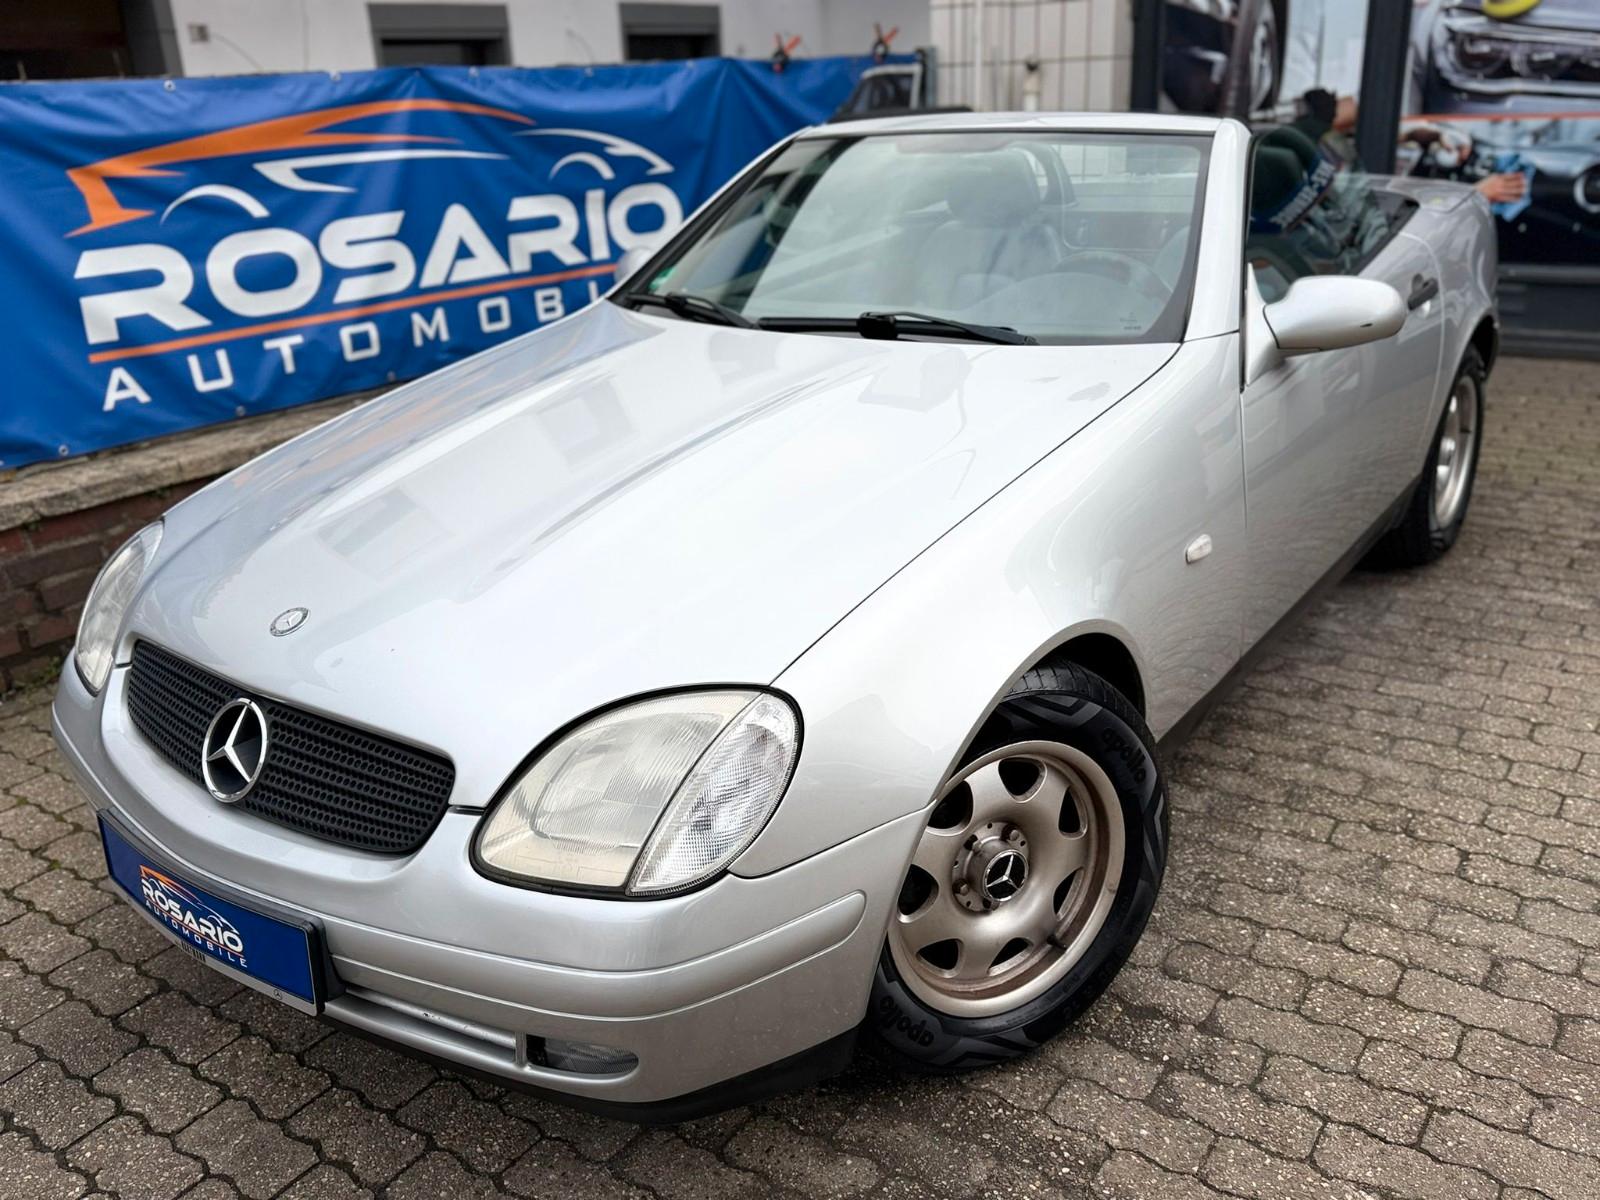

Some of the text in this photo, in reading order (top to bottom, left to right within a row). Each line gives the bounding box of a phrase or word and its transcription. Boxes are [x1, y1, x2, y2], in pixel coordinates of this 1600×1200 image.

[73, 182, 683, 345] ROSARIO
[1102, 727, 1147, 784] apollo
[141, 878, 243, 952] ROSARIO
[145, 899, 247, 968] AUTOMOBILE
